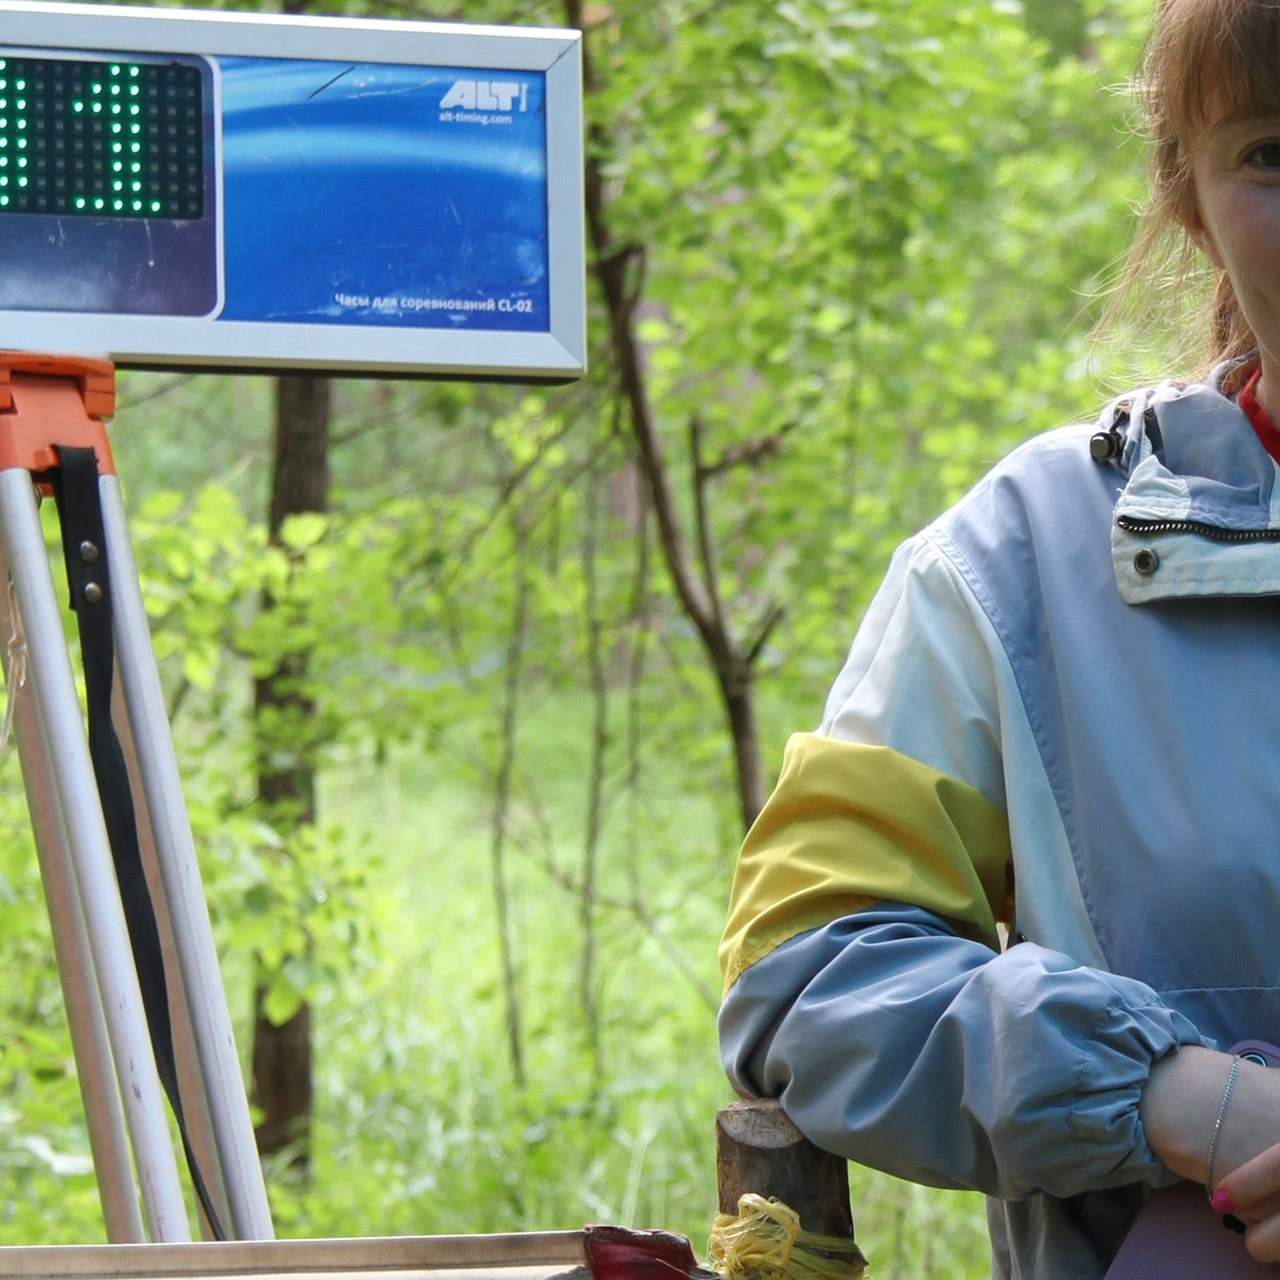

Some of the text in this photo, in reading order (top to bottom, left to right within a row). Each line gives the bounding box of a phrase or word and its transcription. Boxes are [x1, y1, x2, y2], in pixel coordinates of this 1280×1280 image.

[439, 80, 520, 111] ALT
[439, 112, 512, 126] alt-timing.com
[0, 60, 161, 213] 1
[335, 293, 533, 313] Часы для соревнований CL-02
